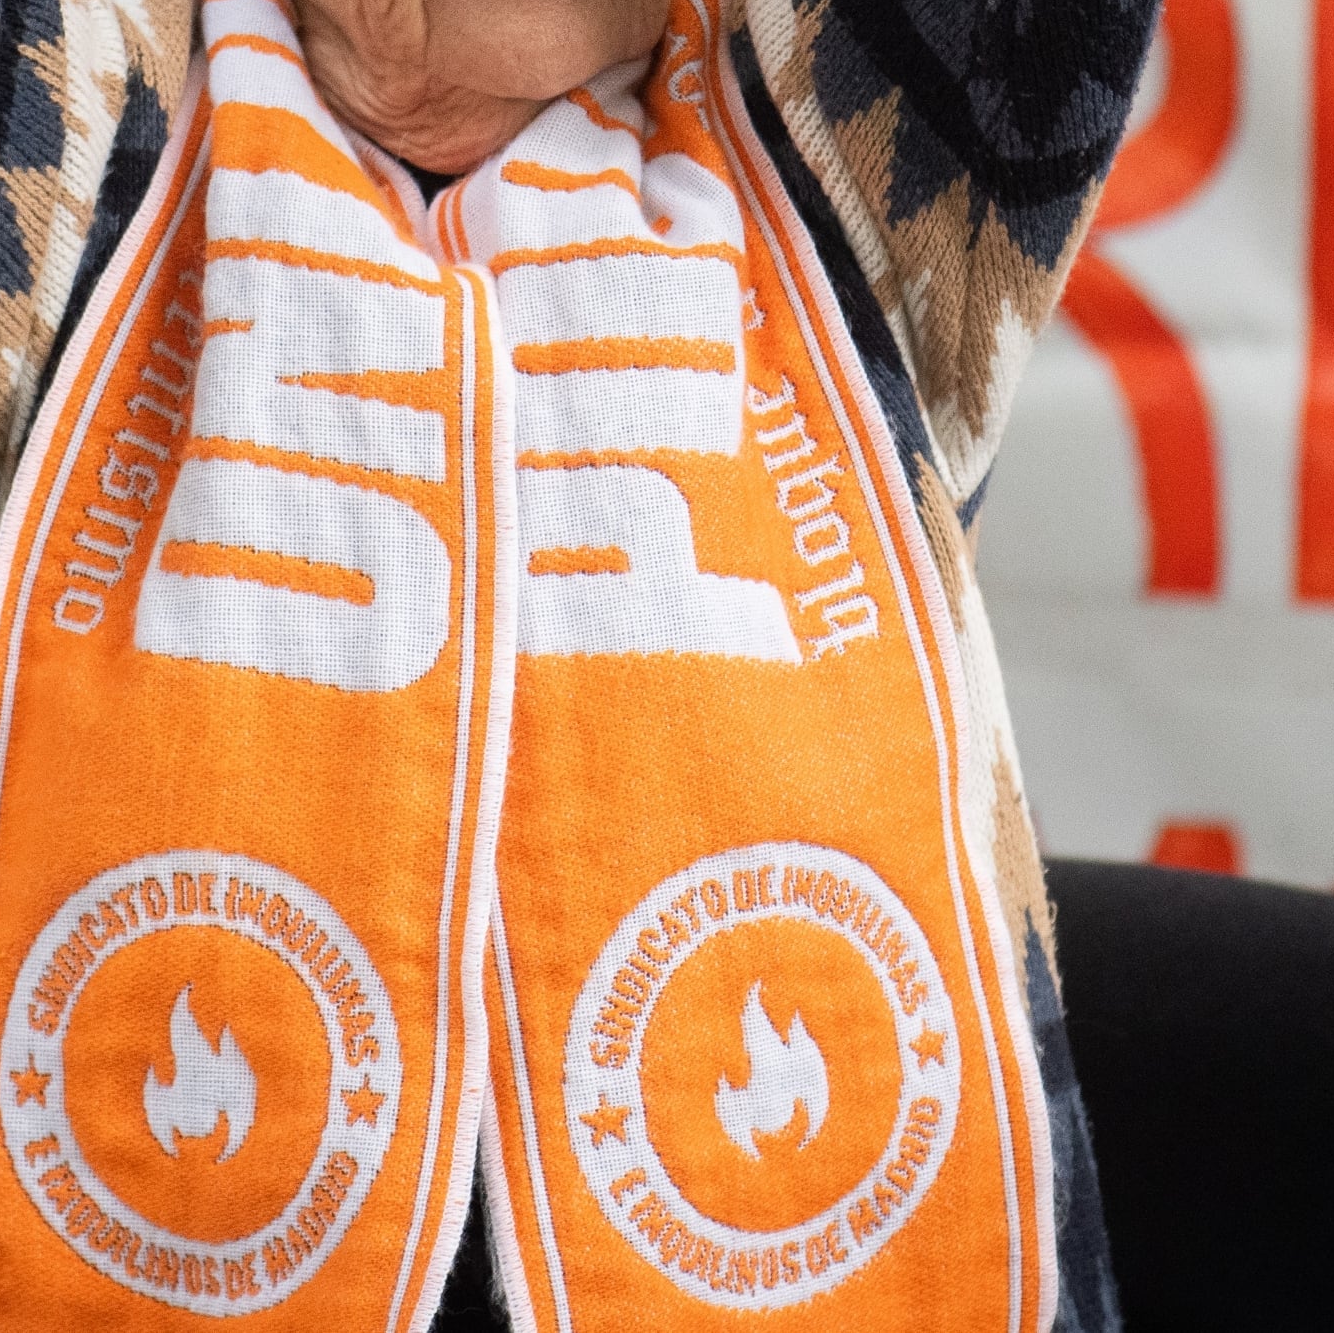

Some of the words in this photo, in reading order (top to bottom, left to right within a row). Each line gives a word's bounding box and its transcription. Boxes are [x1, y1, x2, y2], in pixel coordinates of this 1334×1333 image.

[746, 373, 879, 662] bloque
[173, 872, 219, 918] DE
[589, 878, 728, 1070] SINDICATO
[224, 1250, 263, 1300] DE
[805, 1222, 849, 1277] DE
[846, 1095, 943, 1248] MADRID
